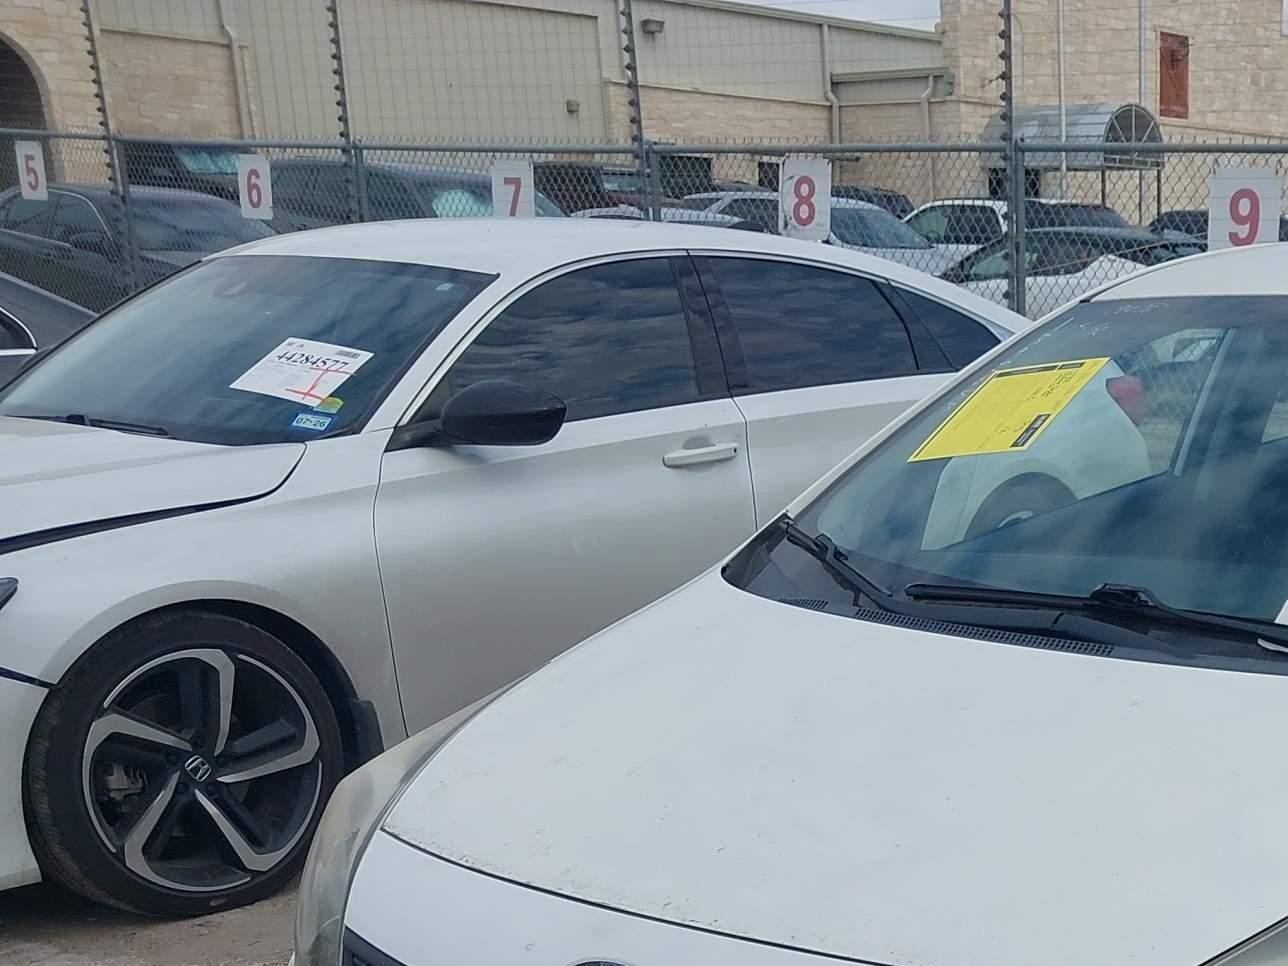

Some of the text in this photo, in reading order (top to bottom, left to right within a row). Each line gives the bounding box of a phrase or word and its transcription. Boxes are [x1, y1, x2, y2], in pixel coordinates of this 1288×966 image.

[24, 154, 39, 192] 5
[246, 168, 262, 208] 6
[503, 176, 521, 217] 7
[793, 175, 816, 226] 8
[1228, 188, 1260, 247] 9
